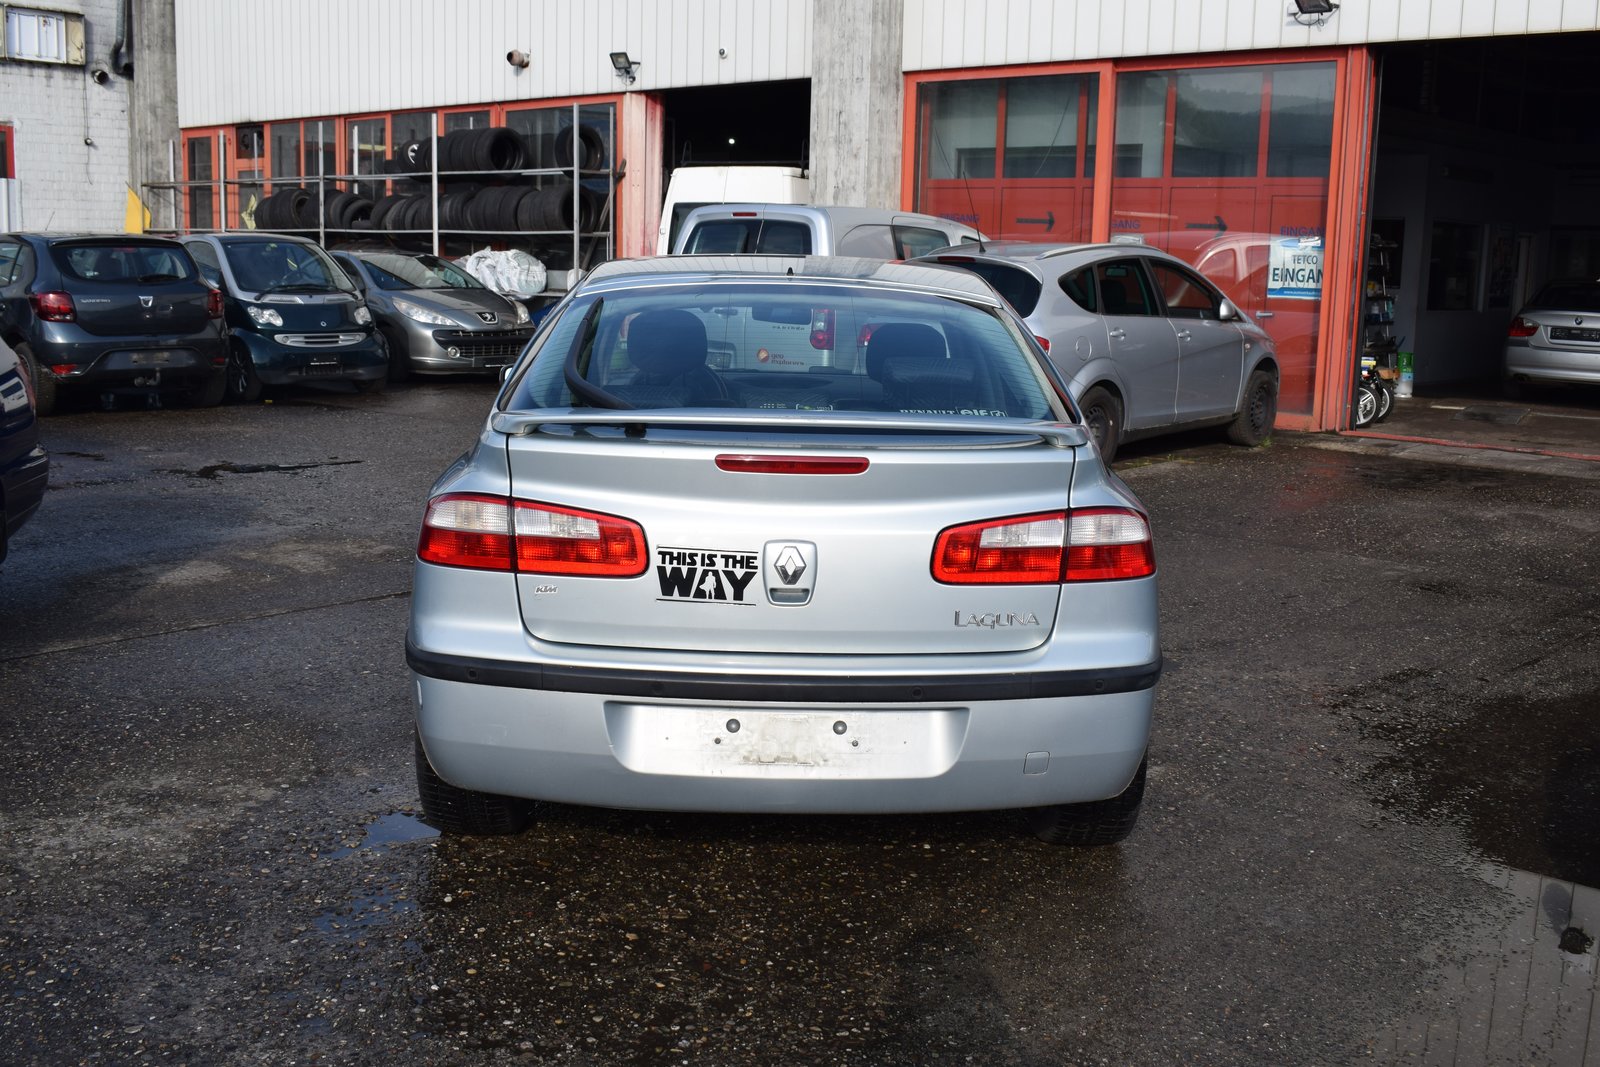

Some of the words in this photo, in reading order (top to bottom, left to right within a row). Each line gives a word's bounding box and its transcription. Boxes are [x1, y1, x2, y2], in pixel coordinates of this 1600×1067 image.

[1292, 254, 1319, 265] TETCO
[658, 551, 699, 566] THIS
[701, 553, 718, 567] IS
[721, 554, 759, 570] THE
[656, 565, 758, 602] WAY
[954, 610, 1040, 630] LAGUNA
